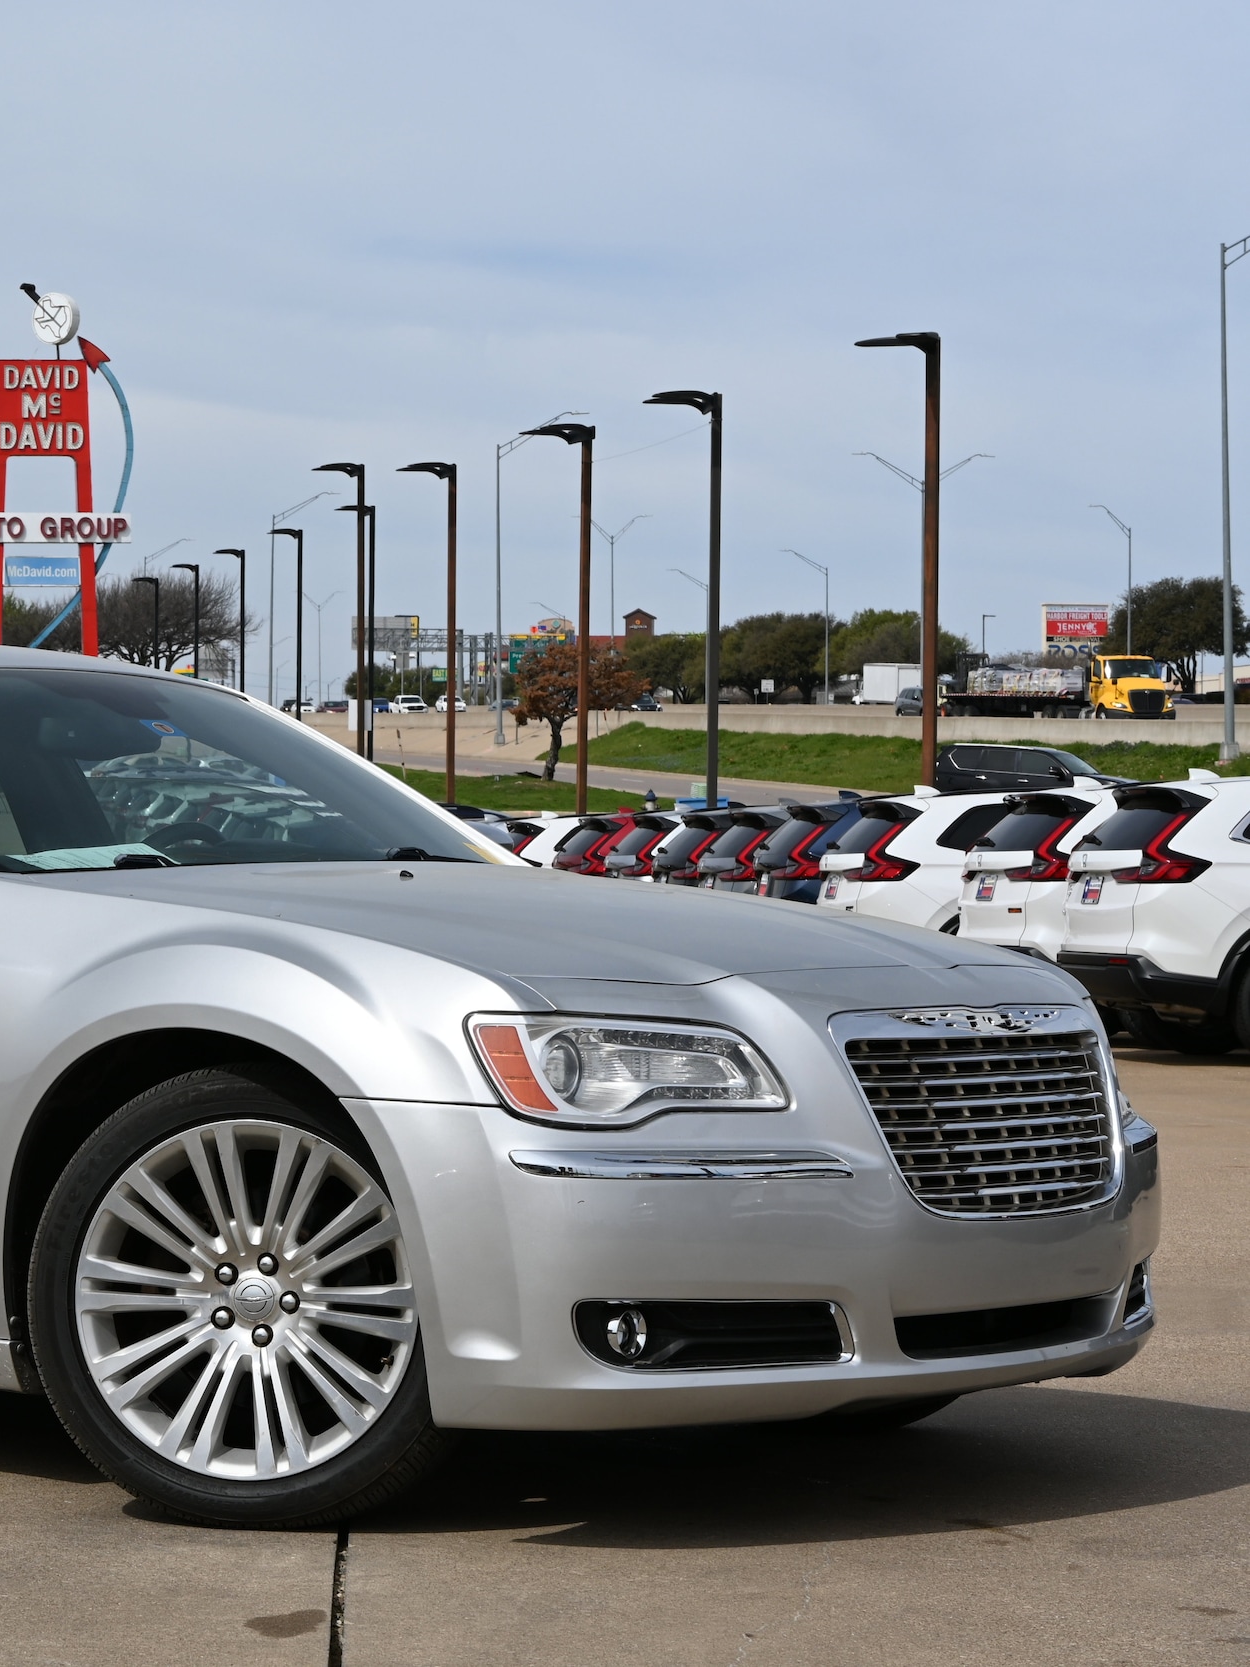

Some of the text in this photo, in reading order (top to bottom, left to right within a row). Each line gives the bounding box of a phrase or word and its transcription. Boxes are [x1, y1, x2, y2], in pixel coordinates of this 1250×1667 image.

[3, 364, 79, 389] DAVID
[21, 392, 61, 419] Mc
[40, 516, 128, 539] GROUP
[6, 565, 77, 578] McDavid.com
